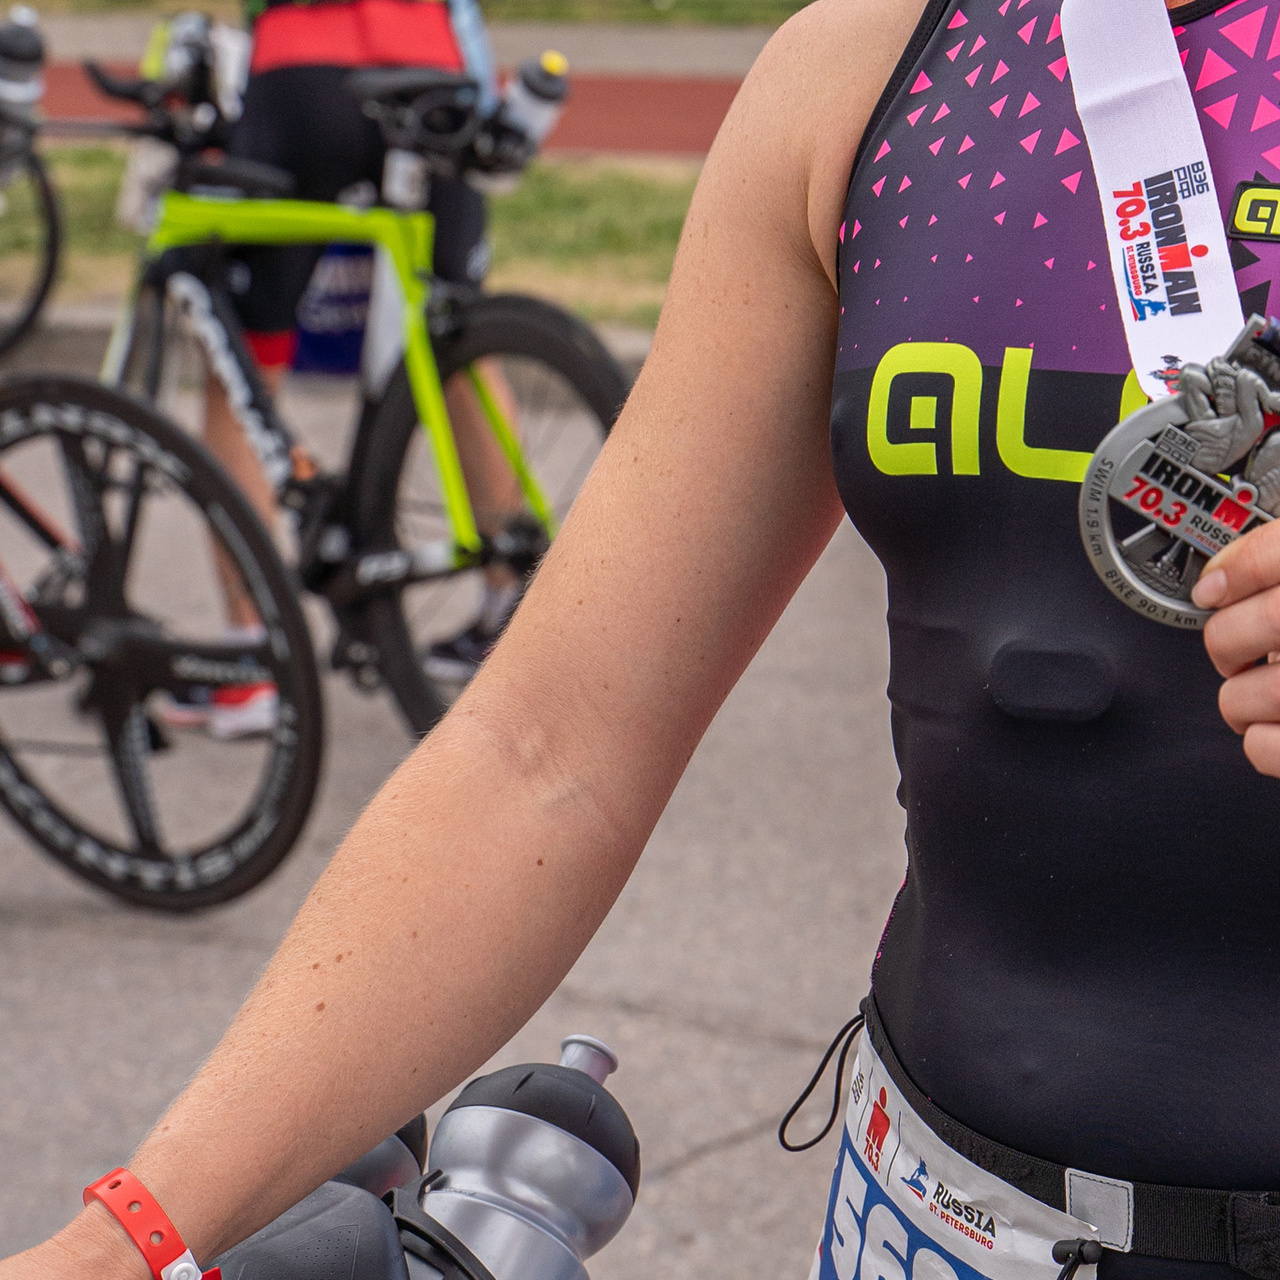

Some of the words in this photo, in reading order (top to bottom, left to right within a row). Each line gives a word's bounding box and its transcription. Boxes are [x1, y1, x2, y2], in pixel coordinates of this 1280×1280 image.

[1112, 181, 1151, 241] 70.3
[1136, 241, 1159, 295] RUSSIA
[1144, 170, 1208, 317] IRONMAN
[1128, 254, 1143, 297] PETERSBURG
[1091, 457, 1114, 505] SWIM
[1140, 450, 1266, 535] IRONM
[1086, 506, 1099, 527] 1.9
[1123, 475, 1188, 528] 70.3
[1189, 514, 1236, 546] RUSS
[1087, 529, 1102, 557] km
[1105, 571, 1134, 599] BIKE
[1137, 598, 1168, 619] 90.1
[1174, 614, 1198, 626] km
[863, 1135, 881, 1174] 70.3
[928, 1201, 939, 1218] ST.
[940, 1212, 994, 1250] PETERSBURG
[932, 1180, 997, 1238] RUSSIA
